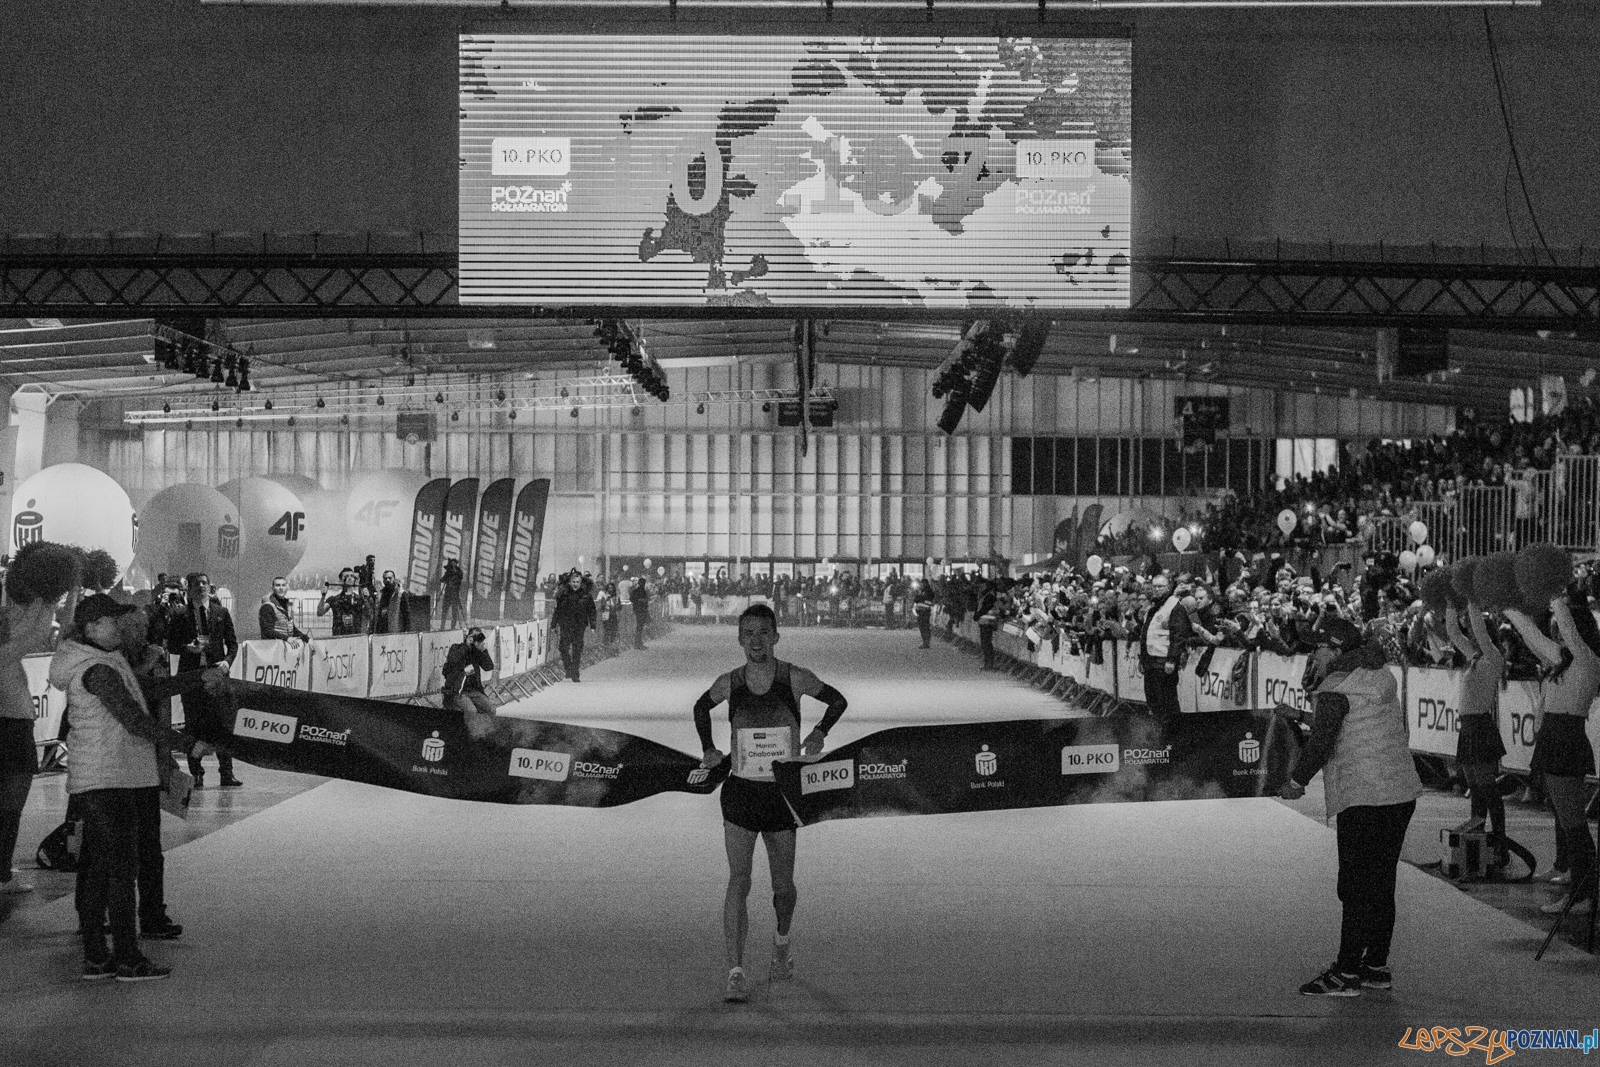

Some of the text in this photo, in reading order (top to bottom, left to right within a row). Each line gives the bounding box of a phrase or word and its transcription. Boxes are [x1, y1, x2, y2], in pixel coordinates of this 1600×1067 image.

[527, 149, 563, 163] PKO
[268, 511, 305, 541] 4F
[242, 717, 290, 734] 10. PKO
[517, 757, 563, 773] 10. PKO
[1068, 752, 1114, 766] 10. PKO
[806, 768, 849, 784] 10. PKO
